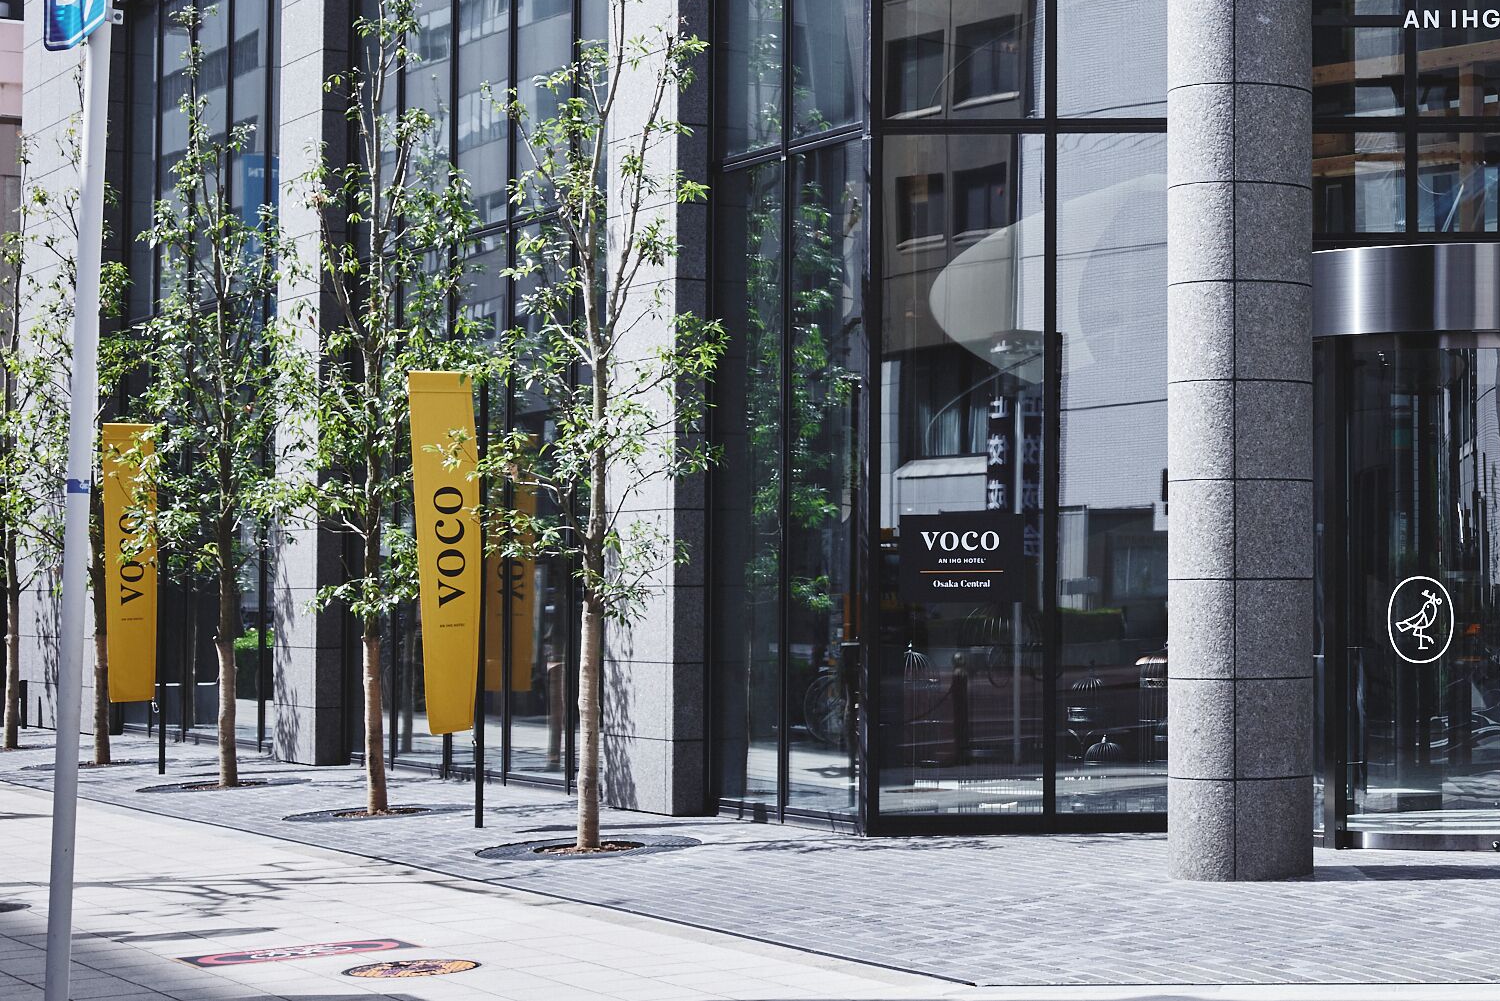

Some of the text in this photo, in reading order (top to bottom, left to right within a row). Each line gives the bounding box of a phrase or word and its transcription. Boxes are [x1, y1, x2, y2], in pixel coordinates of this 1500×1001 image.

[1403, 9, 1440, 29] AN
[1451, 9, 1500, 29] IHG
[933, 579, 991, 588] Osaka Central
